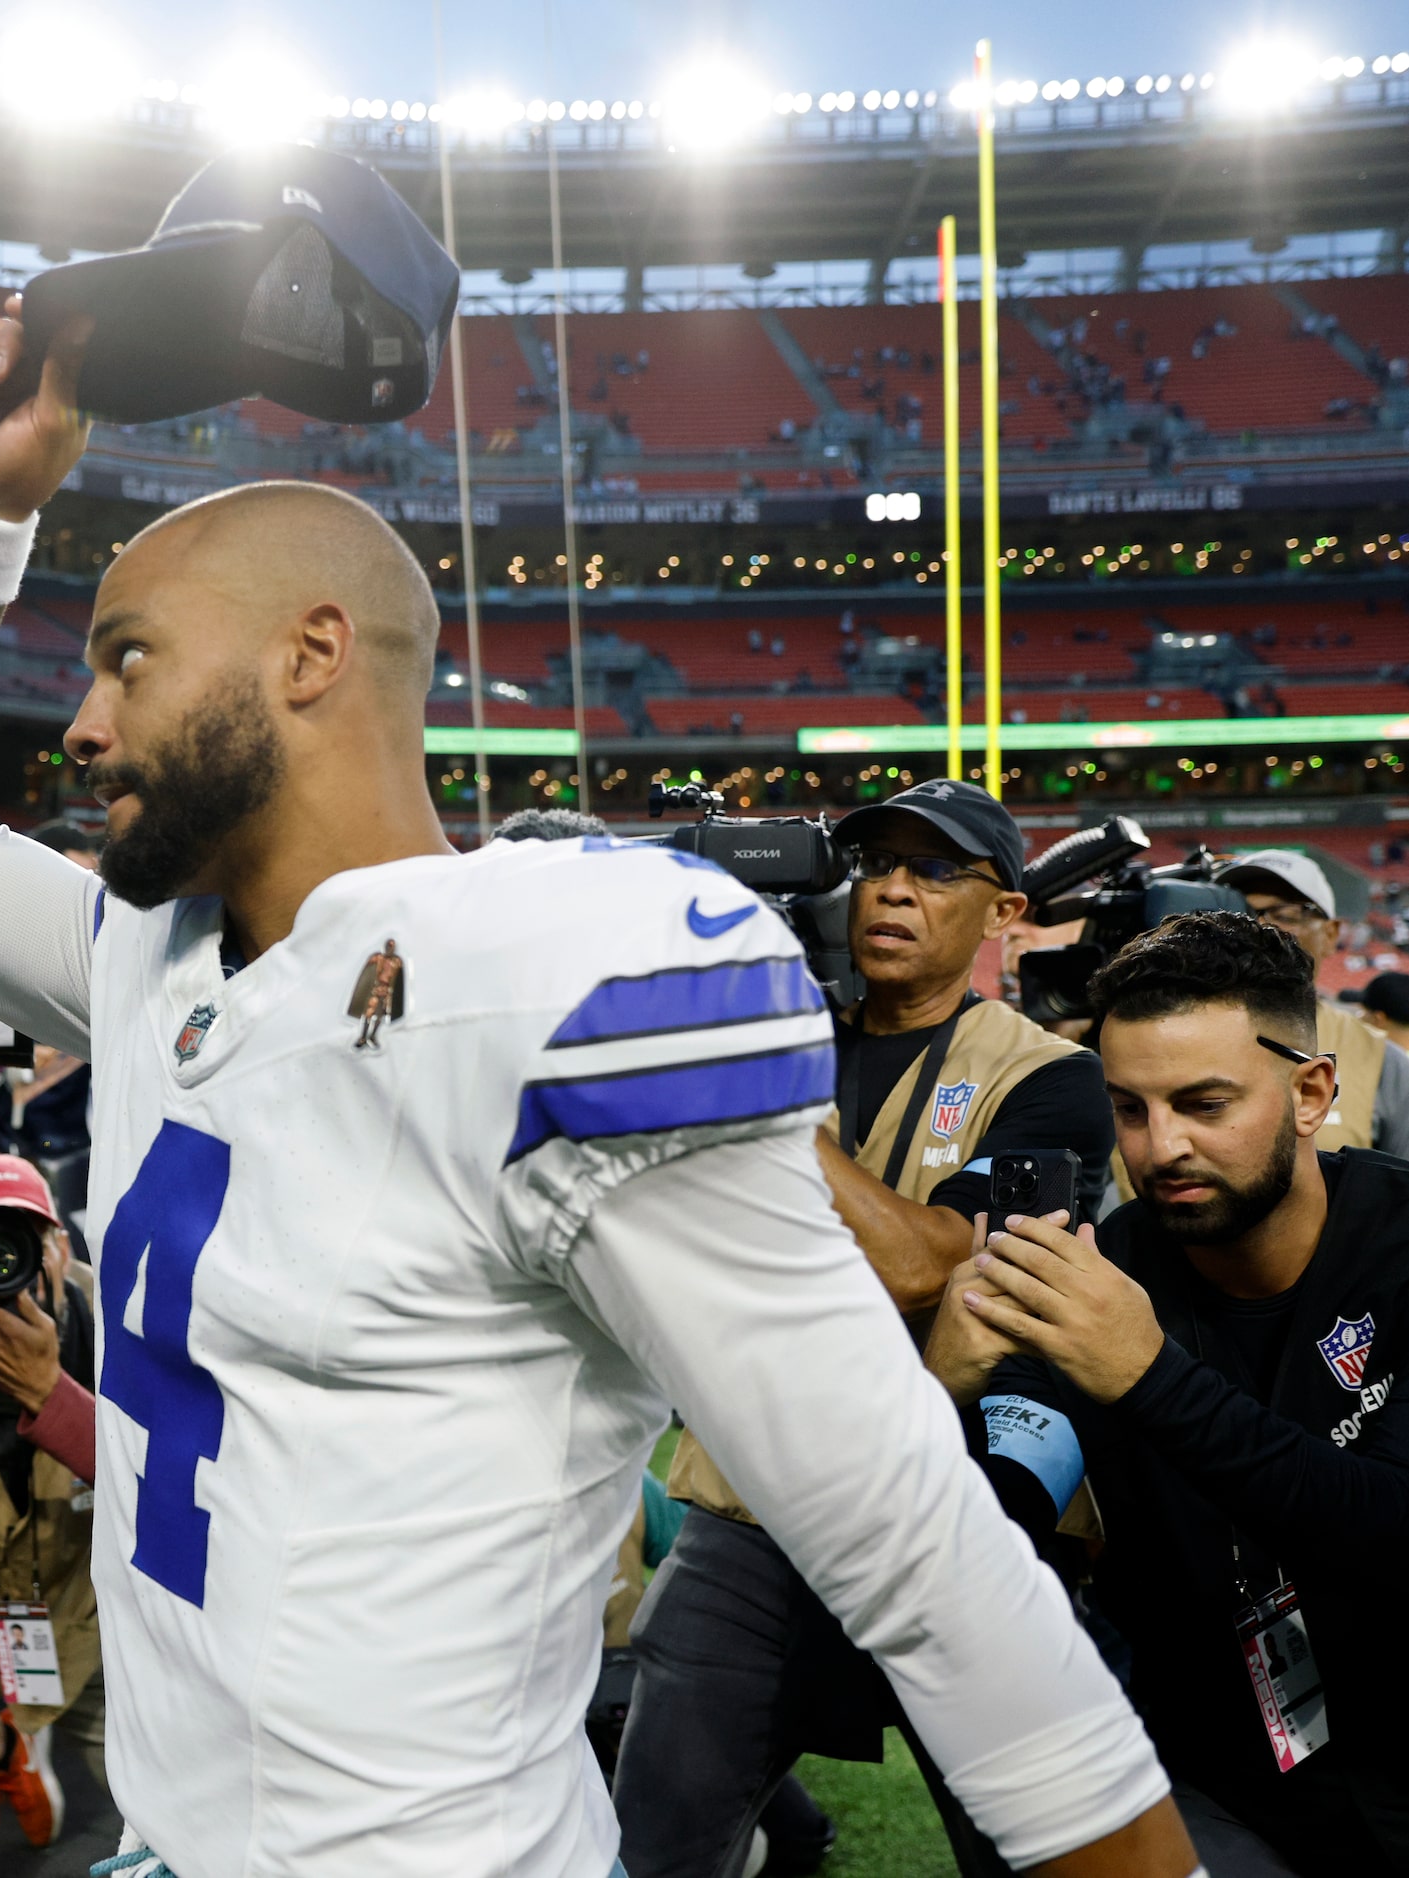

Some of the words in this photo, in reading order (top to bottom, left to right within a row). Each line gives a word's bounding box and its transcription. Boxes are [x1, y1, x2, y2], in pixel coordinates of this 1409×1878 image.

[733, 849, 781, 859] XDCAM
[921, 1143, 960, 1168] MEIA
[99, 1117, 232, 1611] 4
[1335, 1346, 1372, 1384] NF
[1005, 1396, 1028, 1404] CLV
[989, 1418, 1010, 1427] Field
[1012, 1421, 1045, 1441] Access
[1036, 1417, 1051, 1431] 1
[1248, 1653, 1289, 1760] MEDIA
